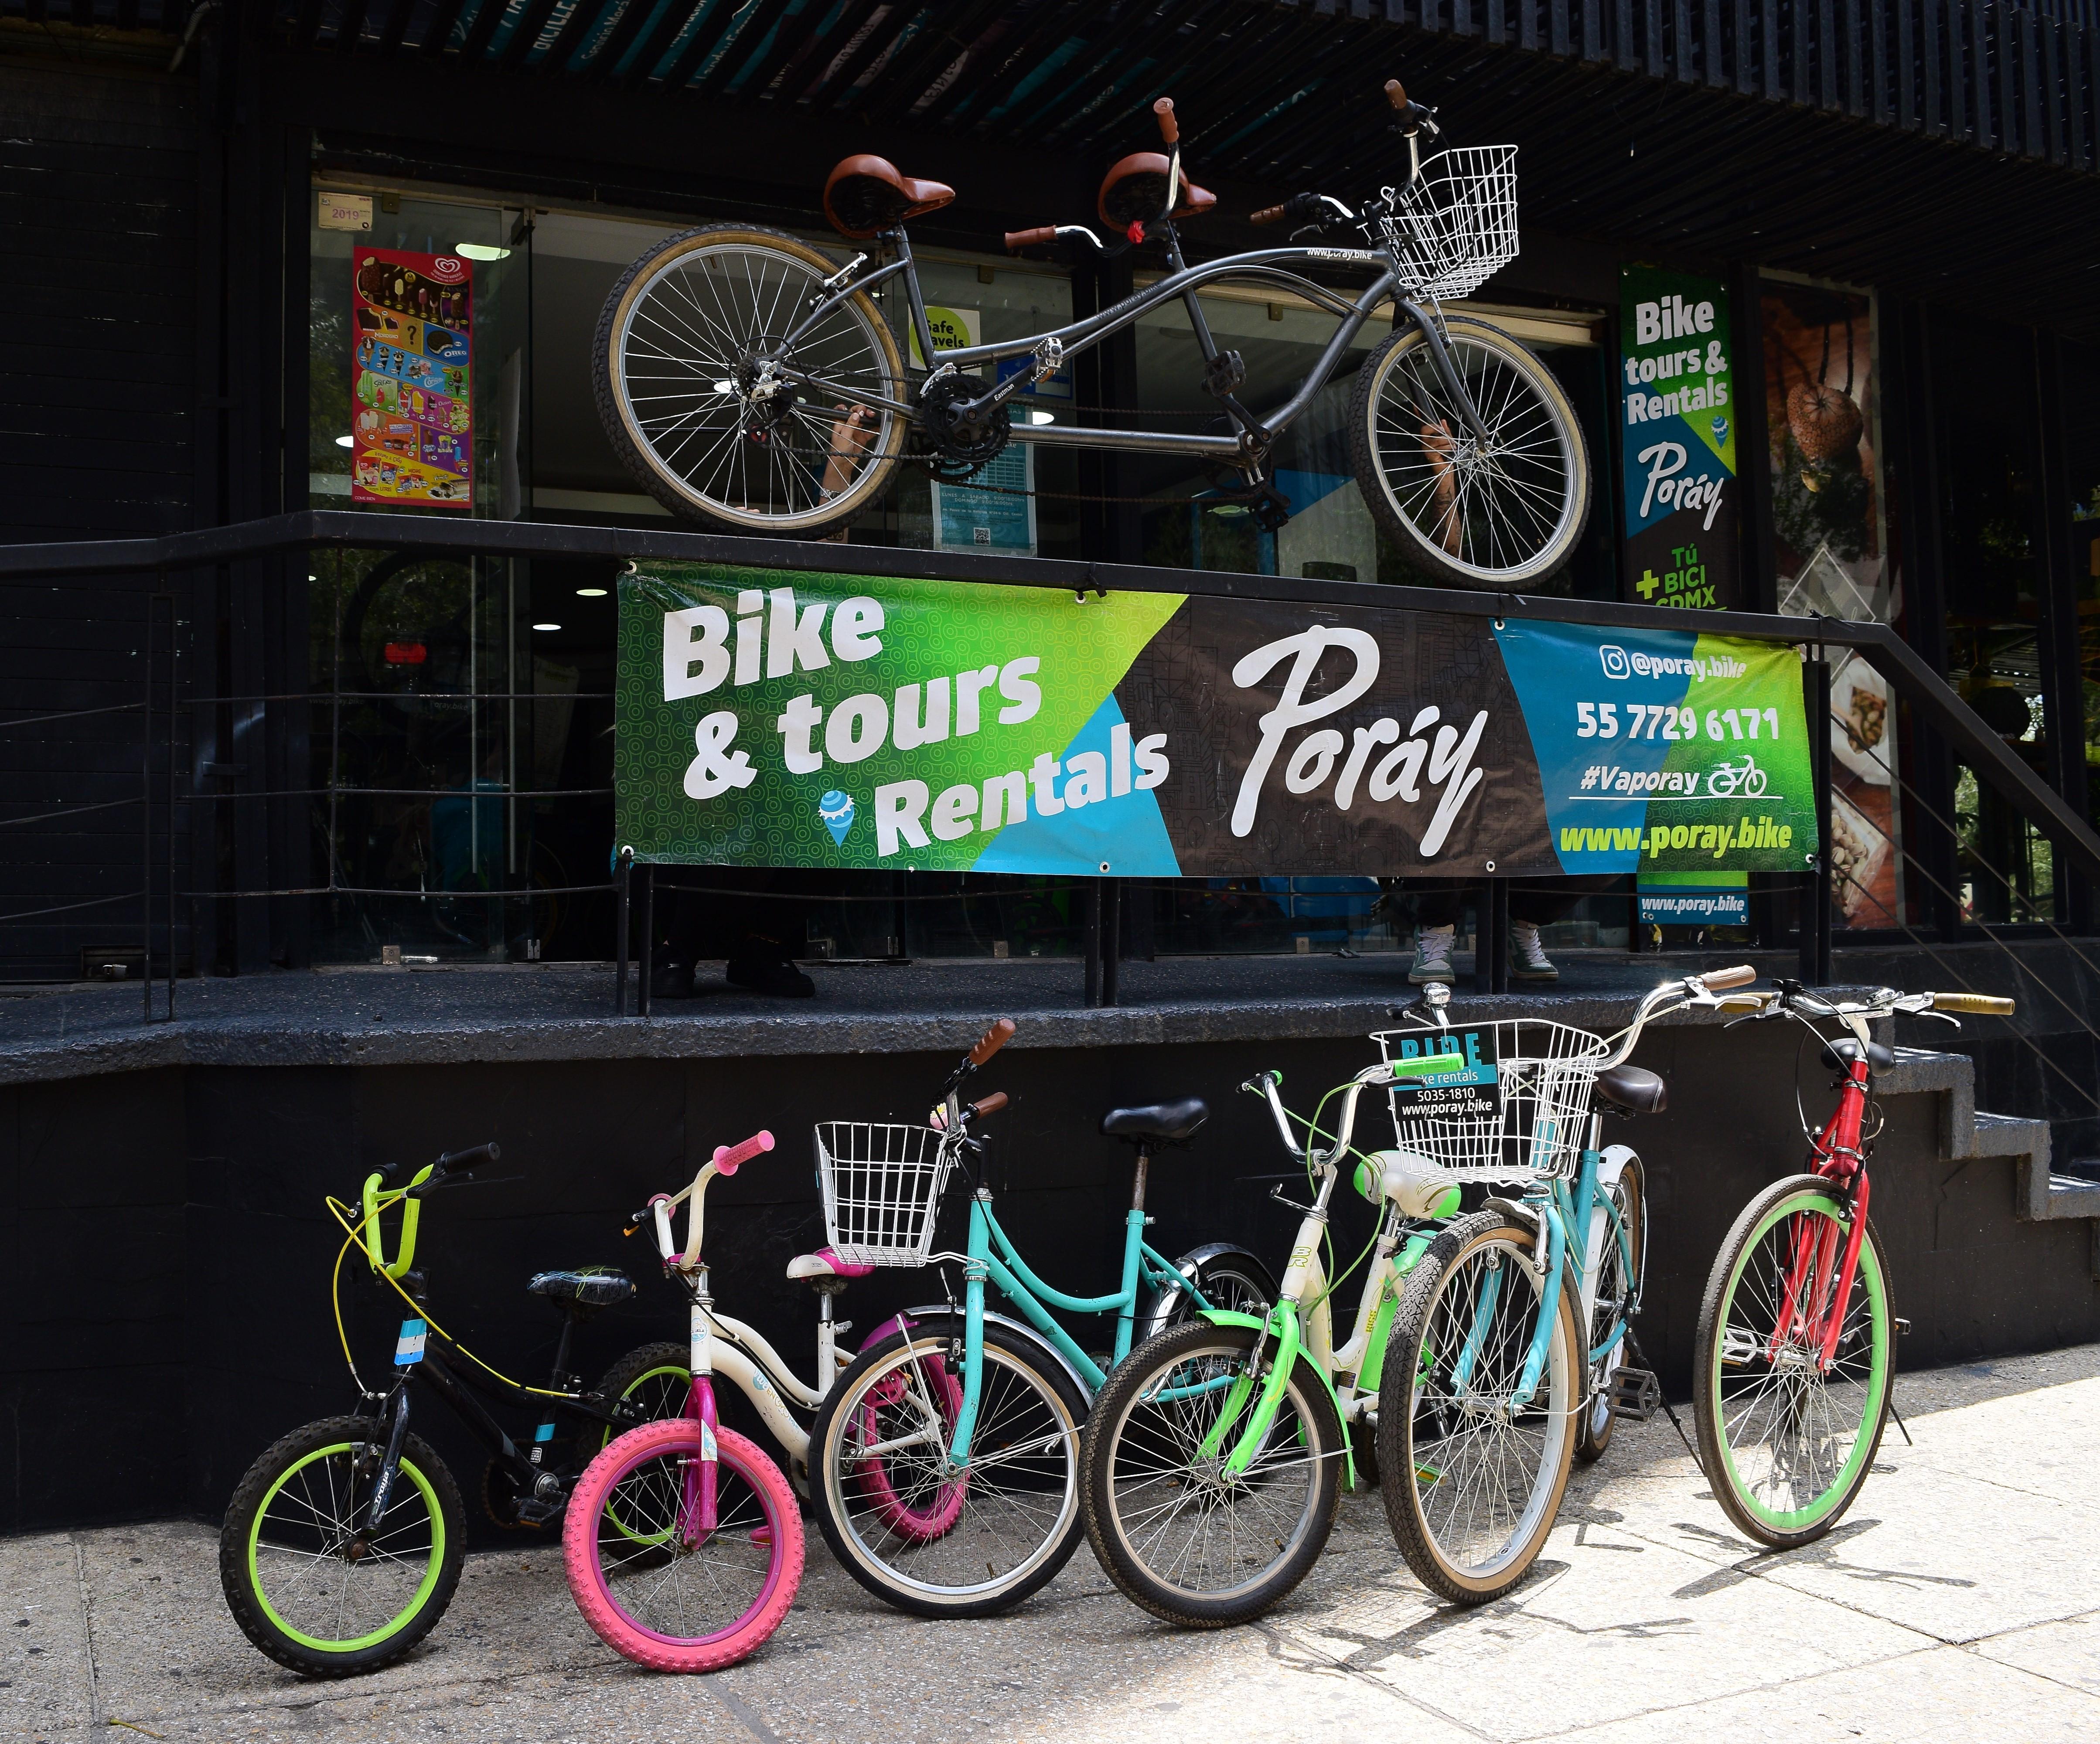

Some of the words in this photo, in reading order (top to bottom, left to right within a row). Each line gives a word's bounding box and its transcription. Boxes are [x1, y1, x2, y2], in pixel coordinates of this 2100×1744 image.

[332, 208, 359, 220] 2019
[1307, 249, 1372, 260] www.poray.bike
[1096, 282, 1161, 320] www.poray.bike
[1636, 295, 1714, 345] Bike
[443, 350, 467, 359] OREO
[1625, 349, 1701, 385] tours
[1705, 340, 1728, 375] &
[1627, 376, 1728, 425] Rentals
[1638, 441, 1724, 531] Poráy
[1672, 543, 1698, 568] Tú
[1664, 565, 1705, 594] BICI
[663, 587, 884, 702] Bike
[1631, 652, 1746, 682] @poray.bike
[684, 711, 757, 799] &
[777, 657, 1041, 774] tours
[1576, 702, 1618, 738] 55
[1626, 705, 1698, 740] 7729
[1705, 708, 1779, 741] 6171
[1231, 625, 1488, 857] Poráy
[875, 722, 1169, 857] Rentals
[1580, 766, 1700, 795] #Vaporay
[1560, 817, 1792, 858] www.poray.bike
[1641, 895, 1745, 915] www.poray.bike
[1438, 1069, 1478, 1083] rentals
[1402, 1098, 1493, 1117] www.poray.bike
[1417, 1087, 1475, 1102] 5035-1810
